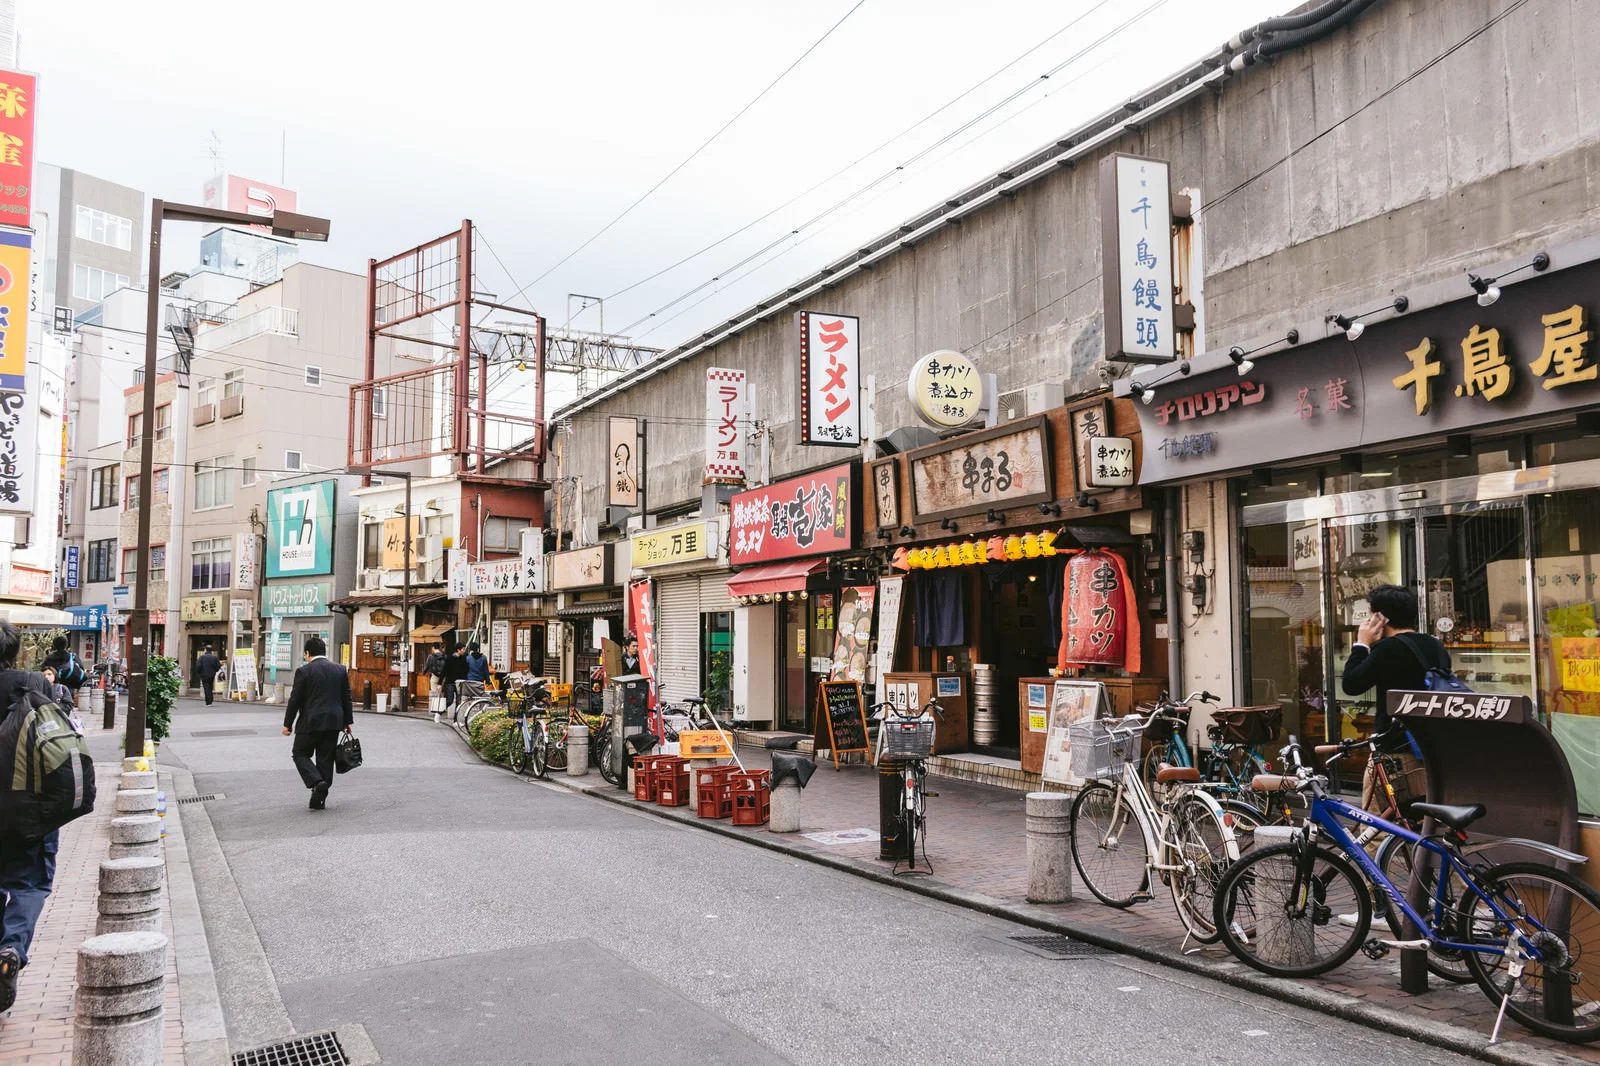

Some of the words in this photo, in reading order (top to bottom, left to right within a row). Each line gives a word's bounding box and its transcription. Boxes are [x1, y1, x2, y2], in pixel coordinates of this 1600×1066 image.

[1131, 197, 1162, 348] 千鳥饅頭
[818, 319, 851, 423] ラーメン
[928, 359, 971, 380] 串カツ
[1295, 377, 1351, 419] 名菓
[1392, 304, 1598, 416] 千鳥屋
[928, 381, 974, 400] 煮込み
[1154, 381, 1265, 426] チロリアン
[718, 386, 738, 447] ラーメン
[717, 450, 738, 461] 万里
[1097, 444, 1133, 460] 串カツ
[962, 450, 1012, 499] 串まる
[1096, 464, 1134, 479] 煮込み
[880, 465, 892, 523] 串カツ
[639, 538, 658, 551] ラーメン
[648, 547, 668, 560] ショップ
[671, 531, 697, 555] 万里
[735, 525, 765, 556] ラーメン
[1089, 561, 1119, 654] 串カツ
[1395, 694, 1443, 716] ルート
[1444, 696, 1511, 720] にっぽり
